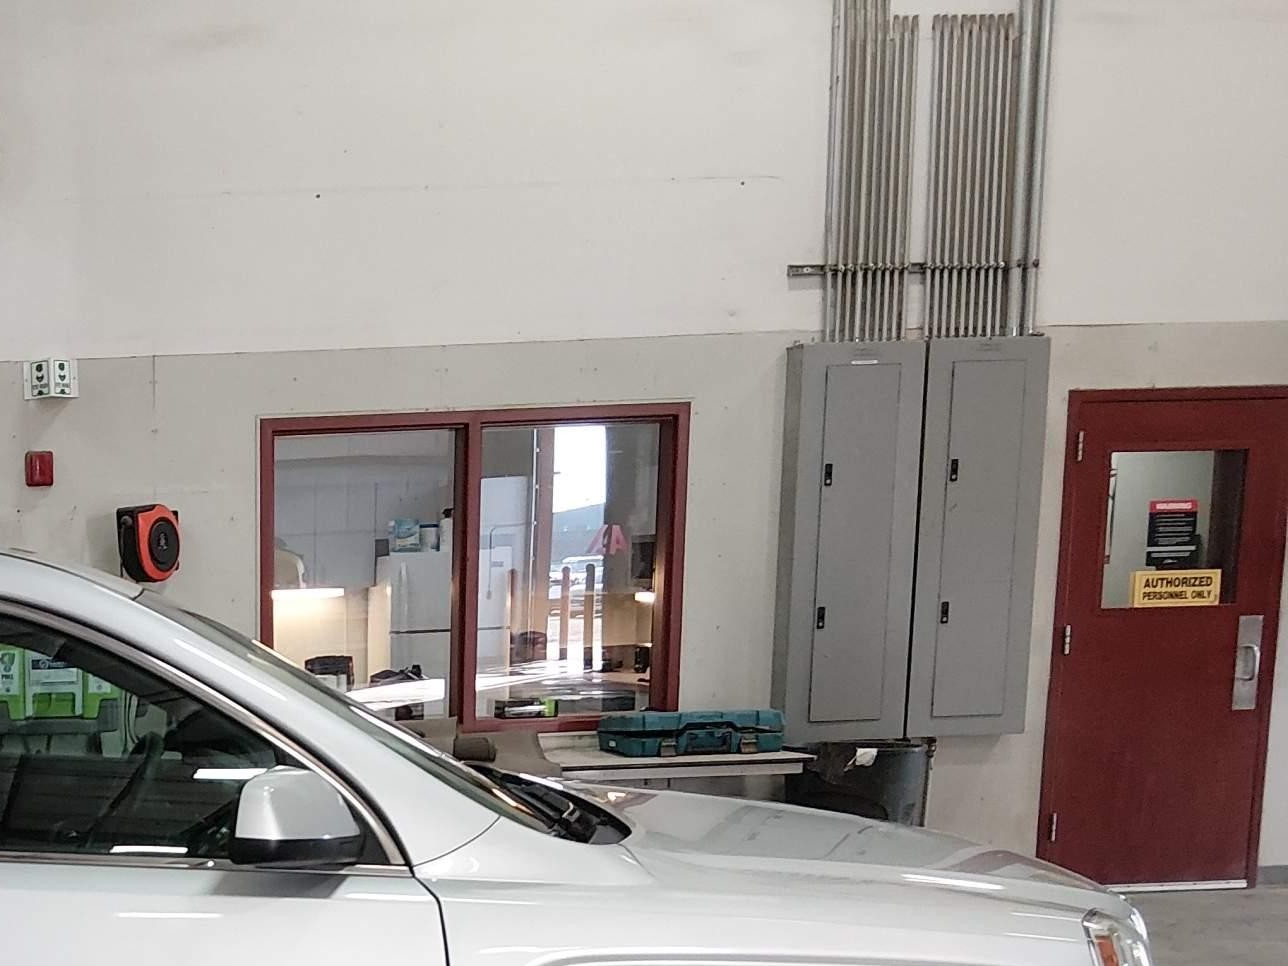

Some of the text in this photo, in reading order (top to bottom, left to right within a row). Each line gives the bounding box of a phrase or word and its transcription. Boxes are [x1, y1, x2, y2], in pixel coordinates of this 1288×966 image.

[1143, 576, 1213, 589] AUTHORIZED
[1142, 590, 1212, 600] PERSONNEL ONLY
